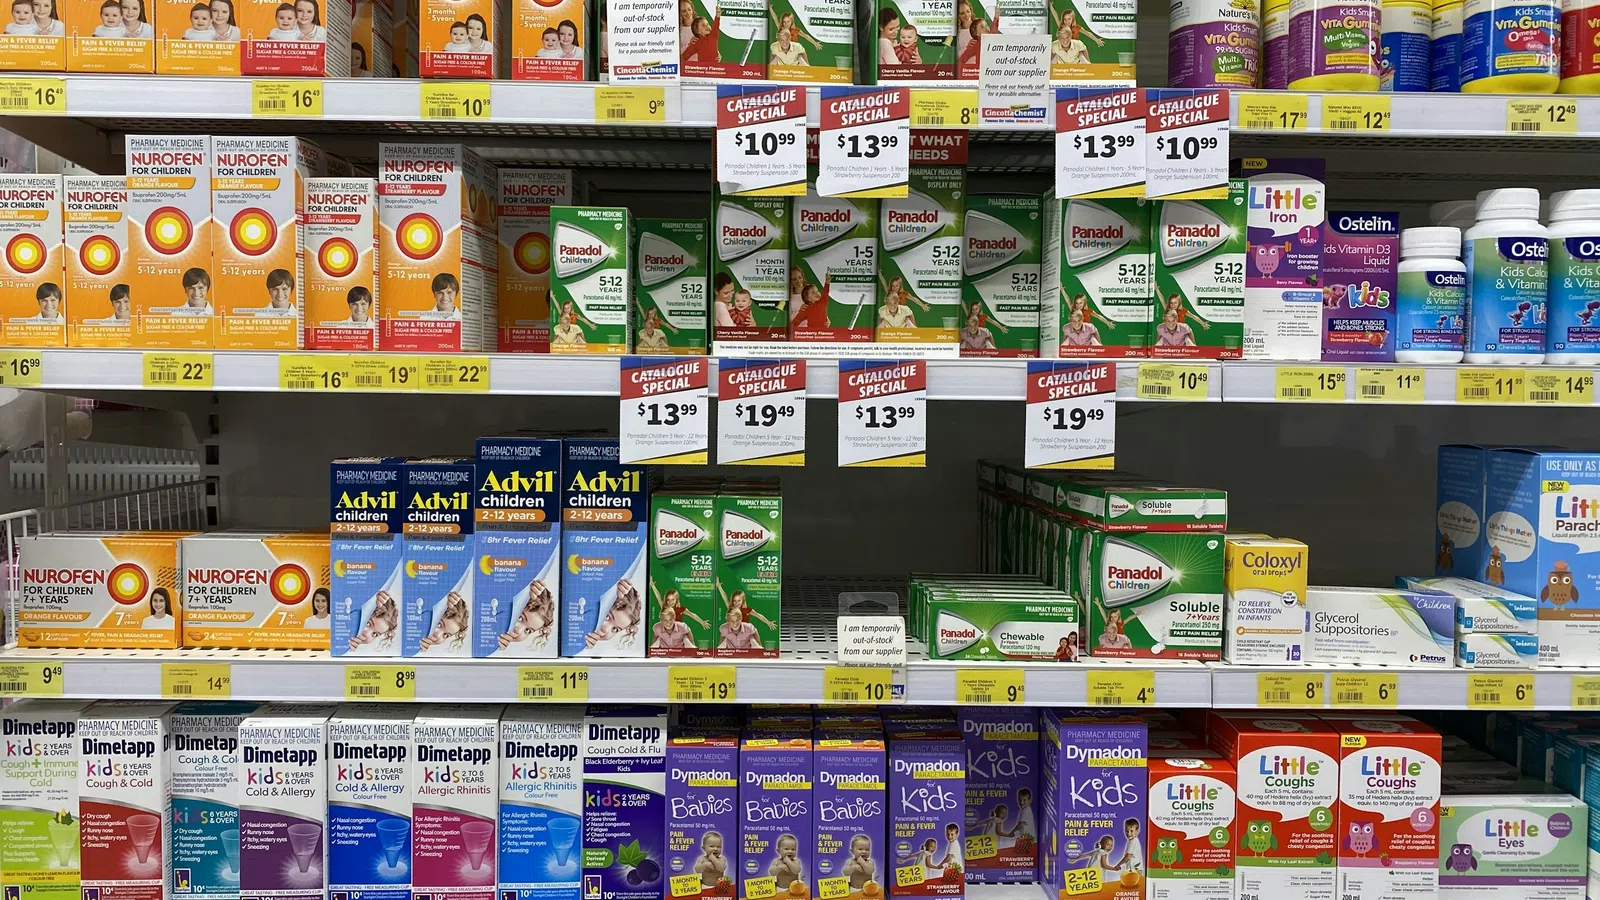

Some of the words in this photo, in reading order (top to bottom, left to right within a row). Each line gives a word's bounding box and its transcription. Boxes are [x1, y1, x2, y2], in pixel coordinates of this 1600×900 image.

[633, 1, 673, 11] temporarily
[624, 13, 665, 22] out-of-stock
[647, 25, 675, 34] supplier
[1006, 44, 1047, 53] temporarily
[996, 56, 1037, 64] out-of-stock
[985, 68, 1002, 76] from
[1018, 68, 1047, 78] supplier
[727, 90, 797, 112] CATALOGUE
[830, 92, 899, 113] CATALOGUE
[1149, 94, 1219, 116] CATALOGUE
[738, 105, 787, 124] SPECIAL
[841, 107, 890, 125] SPECIAL
[1160, 110, 1209, 128] SPECIAL
[131, 139, 169, 148] PHARMACY
[171, 140, 203, 148] MEDICINE
[921, 135, 963, 146] WHAT
[131, 153, 202, 166] NUROFEN
[217, 154, 288, 167] NUROFEN
[150, 167, 191, 175] CHILDREN
[1249, 187, 1318, 210] Little
[801, 209, 850, 222] Panadol
[889, 210, 938, 223] Panadol
[1270, 211, 1297, 223] Iron
[888, 223, 927, 233] Children
[1339, 216, 1391, 231] Ostelin
[1072, 225, 1123, 239] Panadol
[560, 245, 602, 257] Panadol
[1339, 245, 1374, 253] Vitamin
[1376, 245, 1390, 254] D3
[560, 256, 592, 265] Children
[1364, 256, 1390, 266] Liquid
[1118, 263, 1146, 277] 5-12
[599, 276, 622, 288] 5-12
[1348, 281, 1389, 309] kids
[631, 362, 700, 383] CATALOGUE
[849, 365, 916, 387] CATALOGUE
[642, 377, 690, 395] SPECIAL
[859, 380, 907, 398] SPECIAL
[479, 471, 553, 492] Advil
[335, 491, 396, 509] Advil
[481, 494, 544, 508] children
[1142, 501, 1172, 510] Soluble
[335, 510, 388, 522] children
[337, 524, 354, 532] 2-12
[356, 524, 381, 534] years
[659, 529, 697, 539] Panadol
[503, 536, 527, 544] Fever
[529, 536, 552, 544] Relief
[1242, 552, 1301, 573] Coloxyl
[24, 569, 104, 584] NUROFEN
[188, 570, 268, 584] NUROFEN
[1108, 566, 1162, 580] Panadol
[24, 586, 39, 595] FOR
[41, 586, 94, 595] CHILDREN
[1108, 580, 1150, 590] Children
[24, 596, 36, 604] 7+
[38, 595, 68, 604] YEARS
[1248, 600, 1272, 608] RELIEVE
[1417, 599, 1452, 610] Children
[1170, 602, 1219, 612] Soluble
[1246, 614, 1272, 622] INFANTS
[1315, 612, 1359, 626] Glycerol
[941, 629, 976, 638] Panadol
[1315, 622, 1389, 637] Suppositories
[853, 635, 893, 644] out-of-stock
[1000, 632, 1044, 642] Chewable
[876, 647, 903, 658] supplier
[1420, 654, 1446, 663] Petrus
[3, 719, 75, 738] Dimetapp
[79, 721, 121, 730] PHARMACY
[122, 720, 157, 730] MEDICINE
[589, 724, 660, 743] Dimetapp
[82, 738, 155, 758] Dimetapp
[588, 746, 616, 756] Cough
[618, 746, 638, 754] Cold
[640, 746, 648, 754] &
[649, 746, 661, 754] Flu
[1066, 745, 1141, 760] Dymadon
[418, 746, 491, 765] Dimetapp
[87, 759, 122, 776] kids
[895, 759, 960, 773] Dymadon
[1259, 755, 1320, 776] Little
[671, 768, 731, 782] Dymadon
[86, 779, 118, 789] Cough
[130, 779, 153, 787] Cold
[1265, 777, 1315, 789] Coughs
[246, 787, 269, 797] Cold
[271, 788, 279, 796] &
[281, 787, 315, 800] Allergy
[418, 785, 454, 797] Allergic
[456, 785, 491, 795] Rhinitis
[1070, 778, 1139, 809] Kids
[671, 796, 733, 819] Babies
[901, 788, 957, 814] Kids
[1485, 818, 1539, 838] Little
[1499, 837, 1525, 849] Eyes
